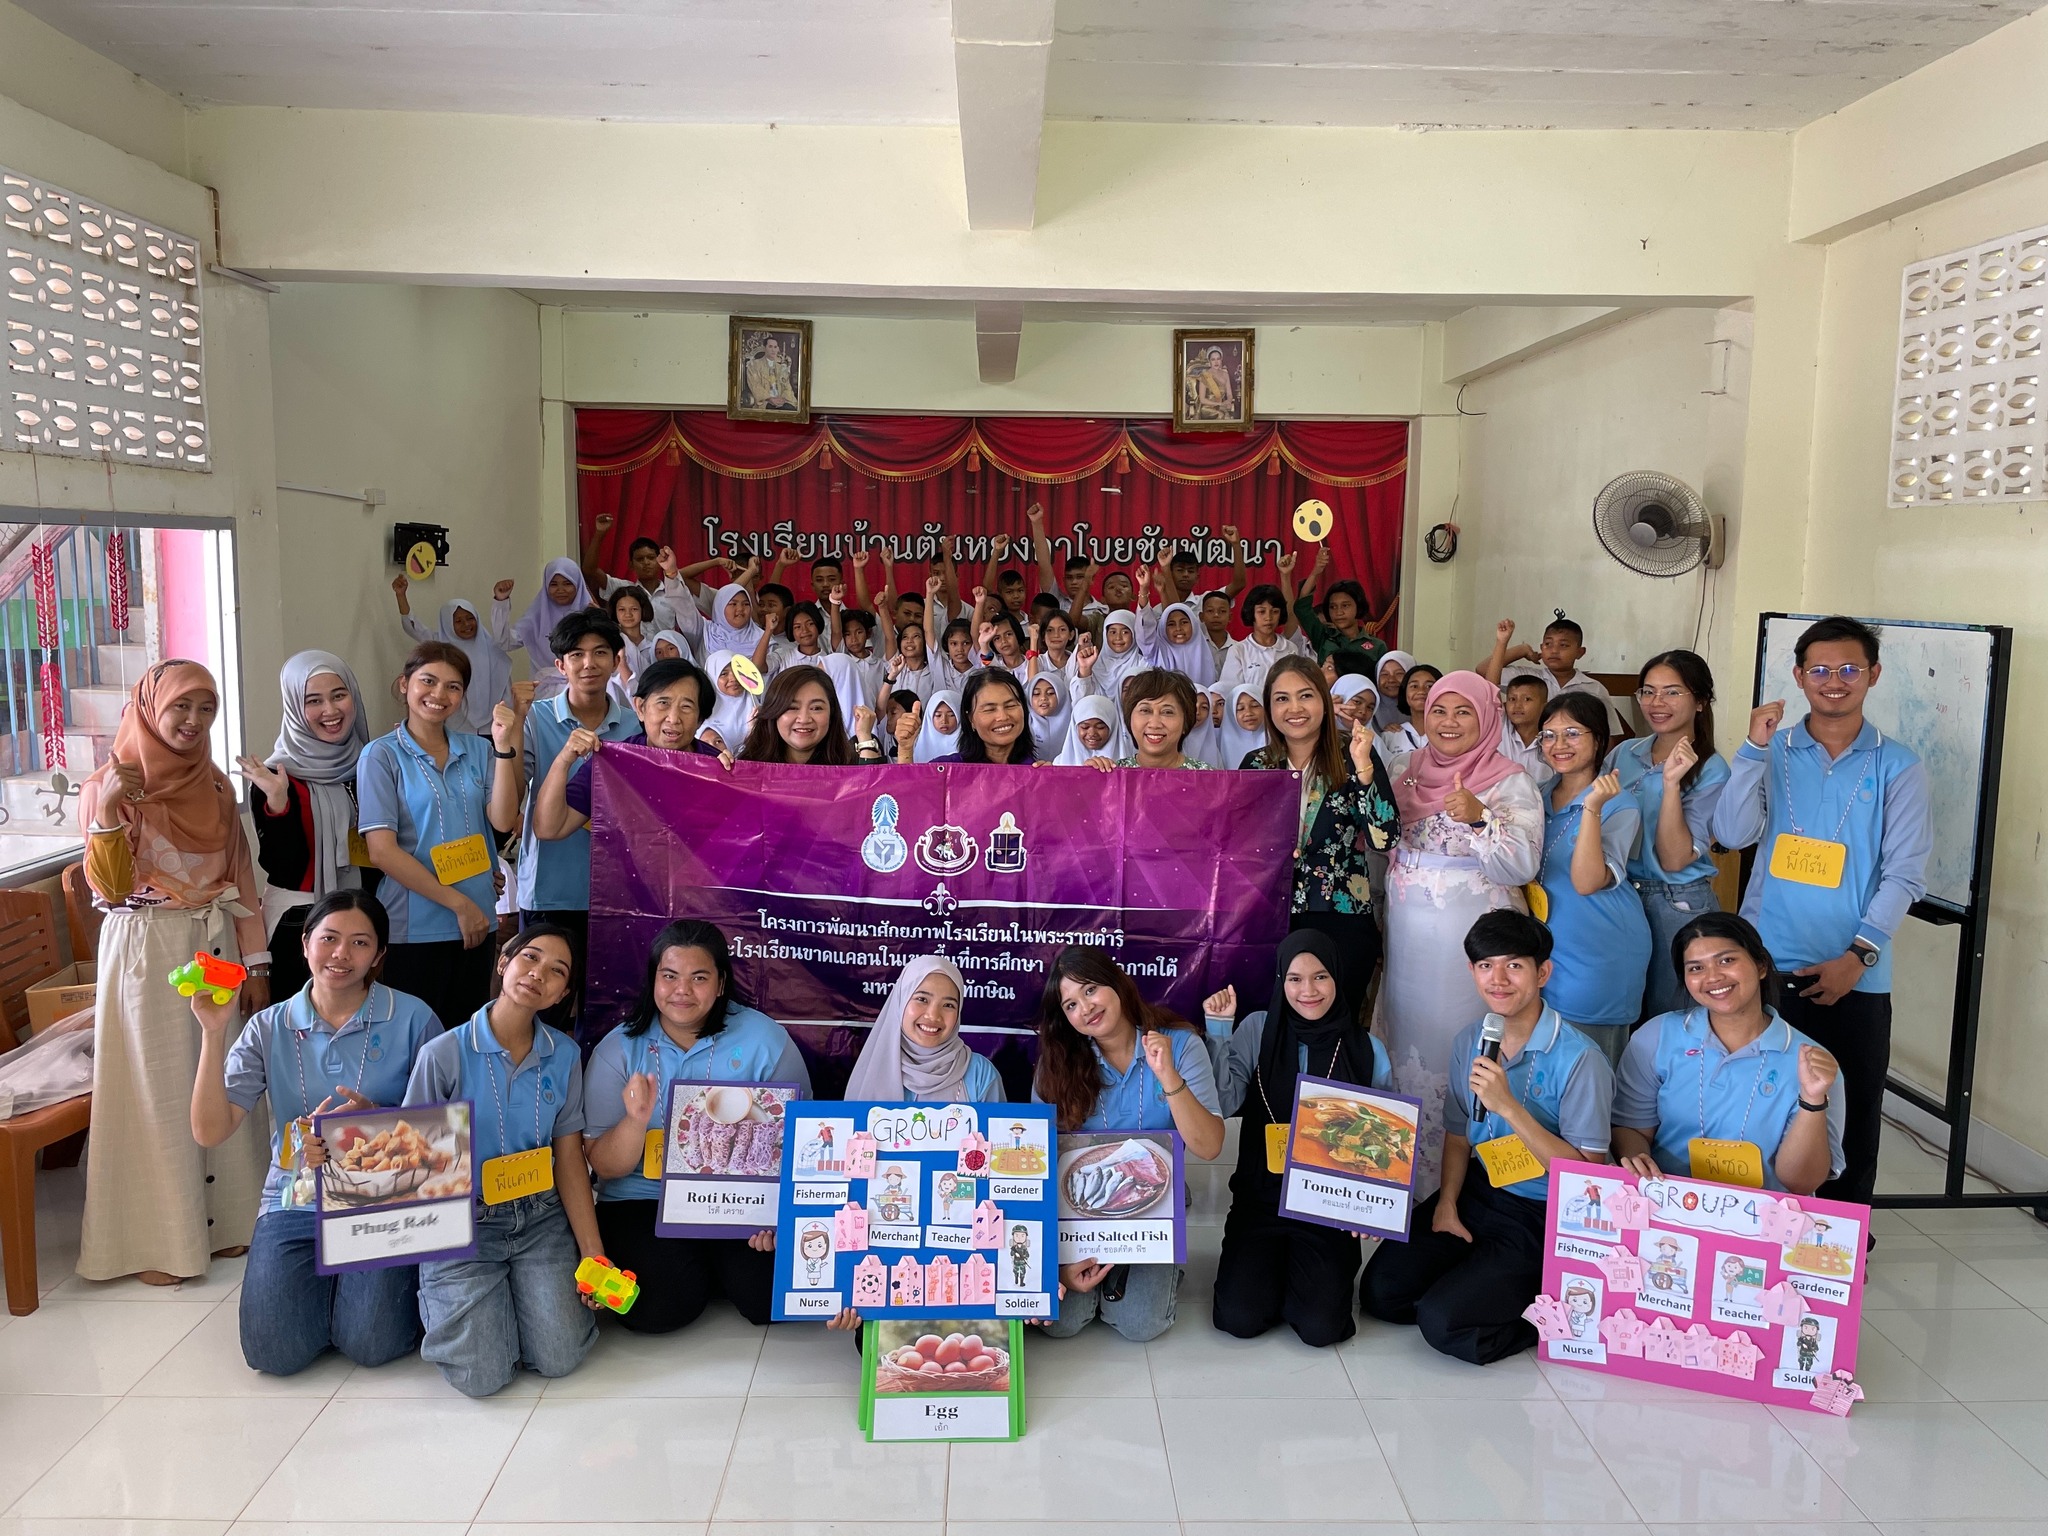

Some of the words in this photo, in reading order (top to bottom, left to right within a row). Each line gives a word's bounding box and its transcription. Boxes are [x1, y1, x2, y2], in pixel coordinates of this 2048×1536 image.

[757, 908, 1125, 947] โครงการพัฒนาศักยภาพโรงเรียนในพระราชดำริ
[873, 1117, 958, 1143] GROUP
[495, 1167, 539, 1192] พี่แคท
[796, 1189, 847, 1199] Fisherman
[993, 1184, 1039, 1195] Gardener
[1302, 1179, 1352, 1199] Tomeh
[1356, 1190, 1397, 1210] Curry
[687, 1191, 717, 1203] Roti
[721, 1192, 765, 1205] Kierai
[1644, 1182, 1739, 1217] GROUP
[1743, 1199, 1760, 1224] 4
[351, 1220, 400, 1237] Phug
[871, 1230, 919, 1242] Merchant
[1060, 1231, 1095, 1242] Dried
[1098, 1231, 1138, 1242] Salted
[1141, 1230, 1168, 1241] Fish
[931, 1231, 971, 1244] Teacher
[1557, 1242, 1610, 1260] Fisherma
[1791, 1280, 1845, 1298] Gardener
[799, 1298, 829, 1308] Nurse
[1005, 1298, 1040, 1308] Soldier
[1638, 1292, 1692, 1312] Merchant
[1717, 1306, 1762, 1322] Teacher
[1562, 1343, 1594, 1356] Nurse
[1784, 1373, 1814, 1385] Soldi
[925, 1404, 959, 1420] Egg
